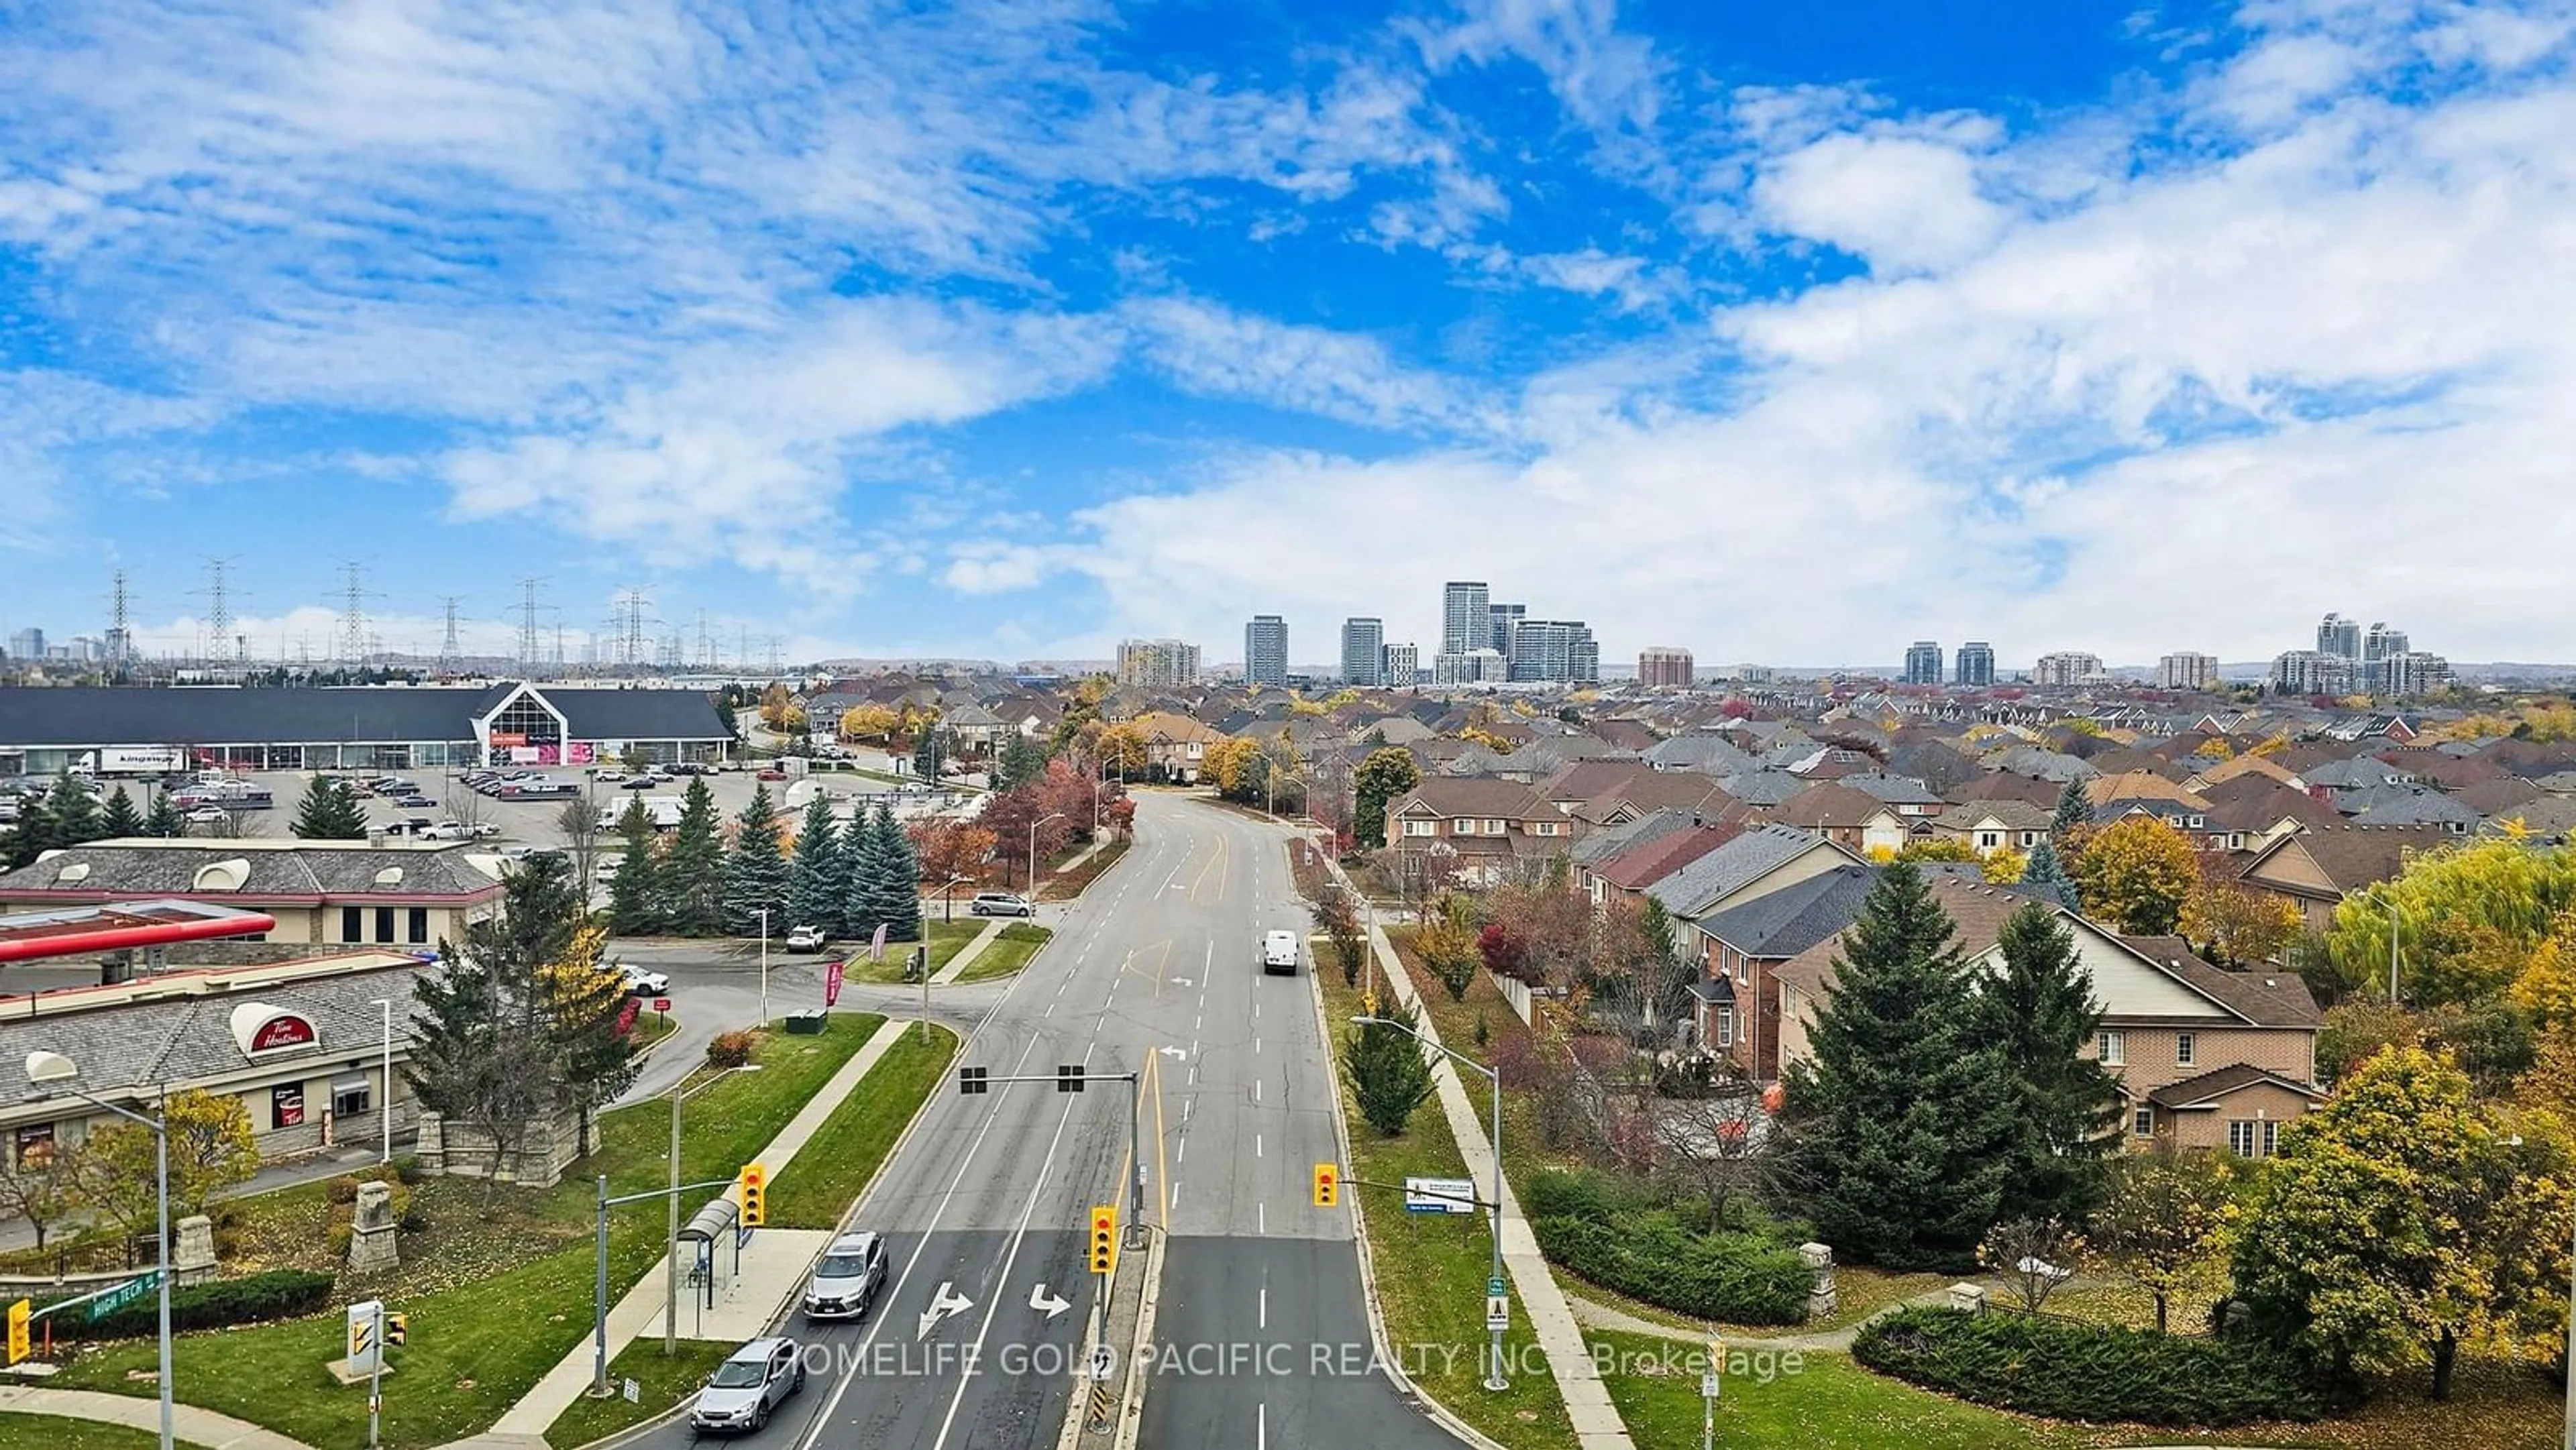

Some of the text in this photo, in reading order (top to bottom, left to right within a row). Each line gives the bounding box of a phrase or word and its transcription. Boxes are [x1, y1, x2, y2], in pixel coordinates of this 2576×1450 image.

[273, 1020, 292, 1034] Tim
[264, 1034, 303, 1047] Hortons
[94, 1294, 117, 1319] HIGH
[120, 1280, 142, 1303] TECH
